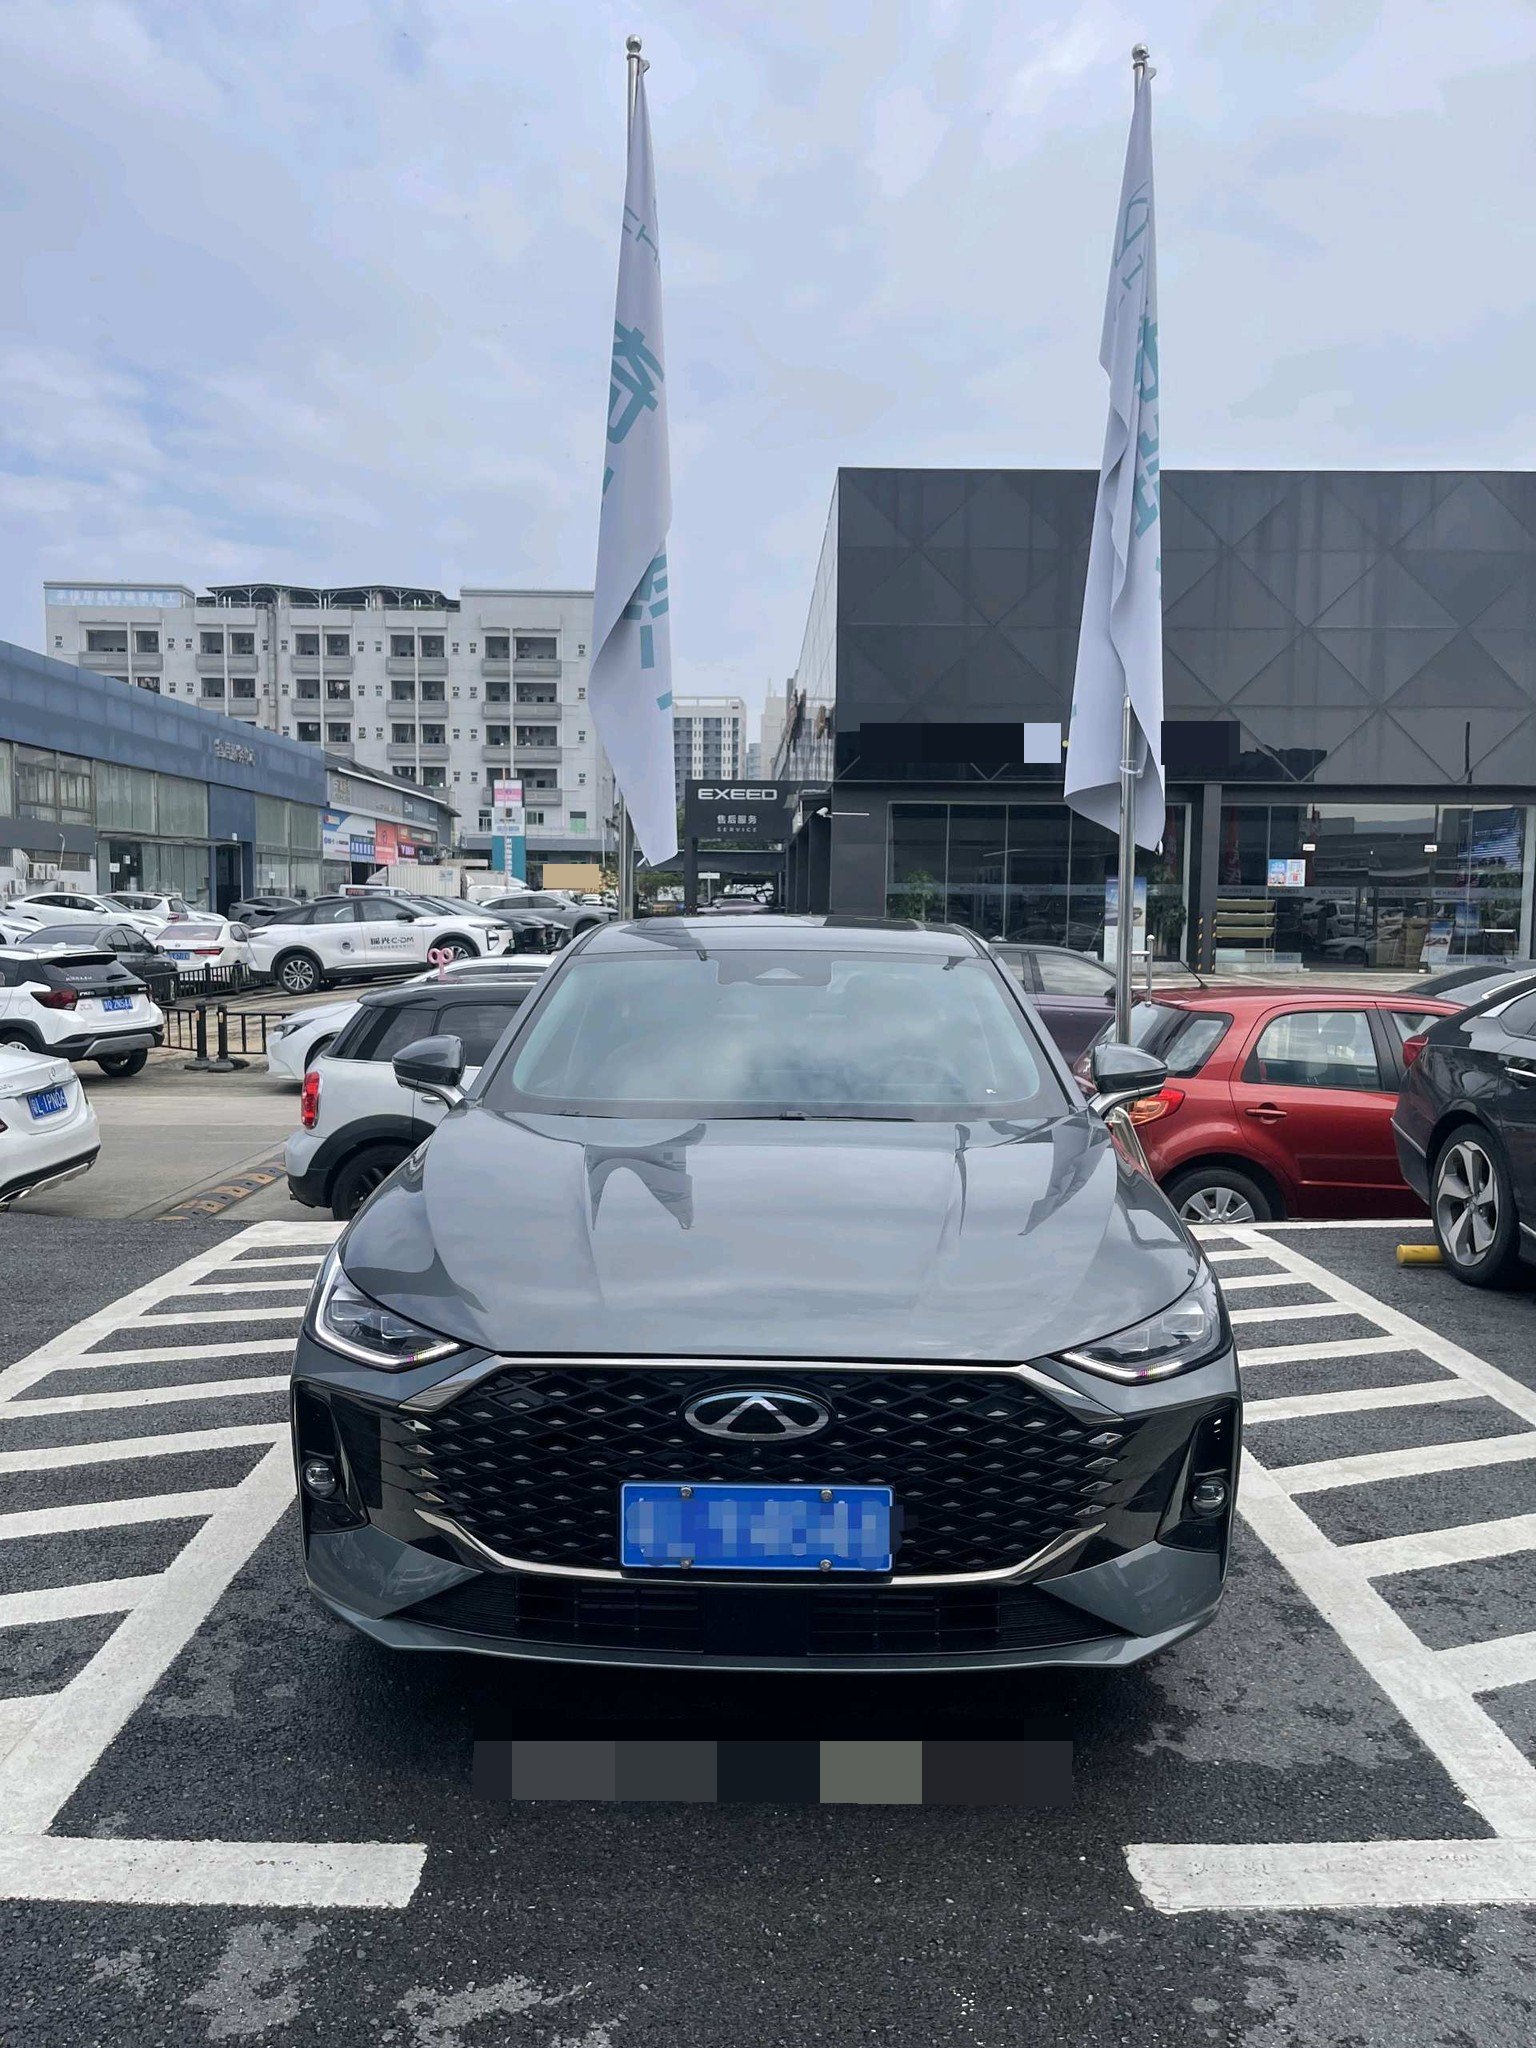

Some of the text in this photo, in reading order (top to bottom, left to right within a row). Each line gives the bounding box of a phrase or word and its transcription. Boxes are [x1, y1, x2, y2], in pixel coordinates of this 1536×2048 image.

[697, 788, 778, 800] EXEED
[717, 814, 757, 825] 售后服务
